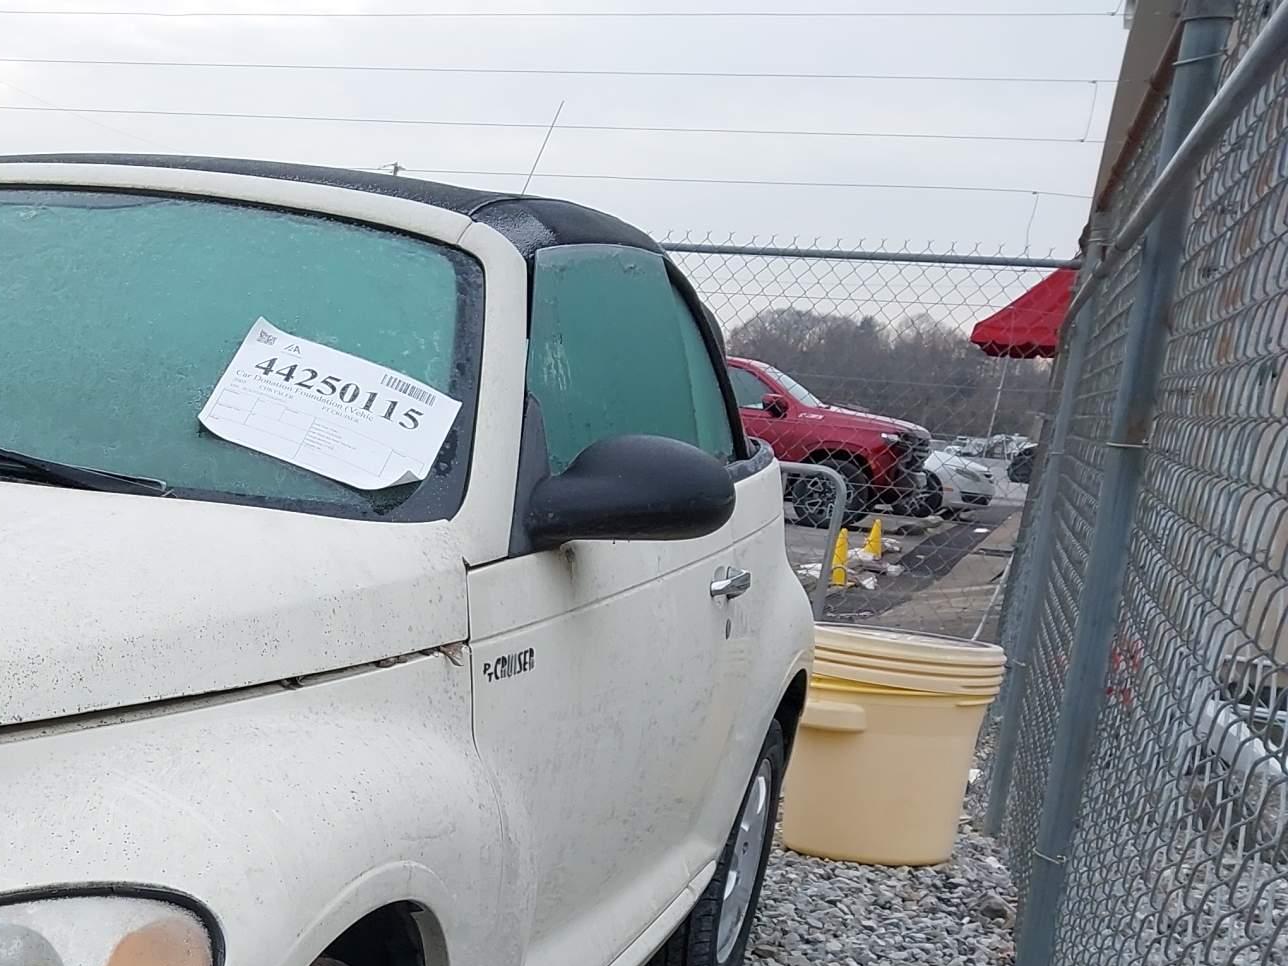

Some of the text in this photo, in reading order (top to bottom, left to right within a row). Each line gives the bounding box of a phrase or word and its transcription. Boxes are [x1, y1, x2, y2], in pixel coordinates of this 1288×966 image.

[236, 369, 252, 378] Car
[254, 374, 293, 391] Donation
[295, 387, 343, 409] Foundation
[255, 357, 424, 430] 44250115
[483, 647, 535, 682] PT CRUISER
